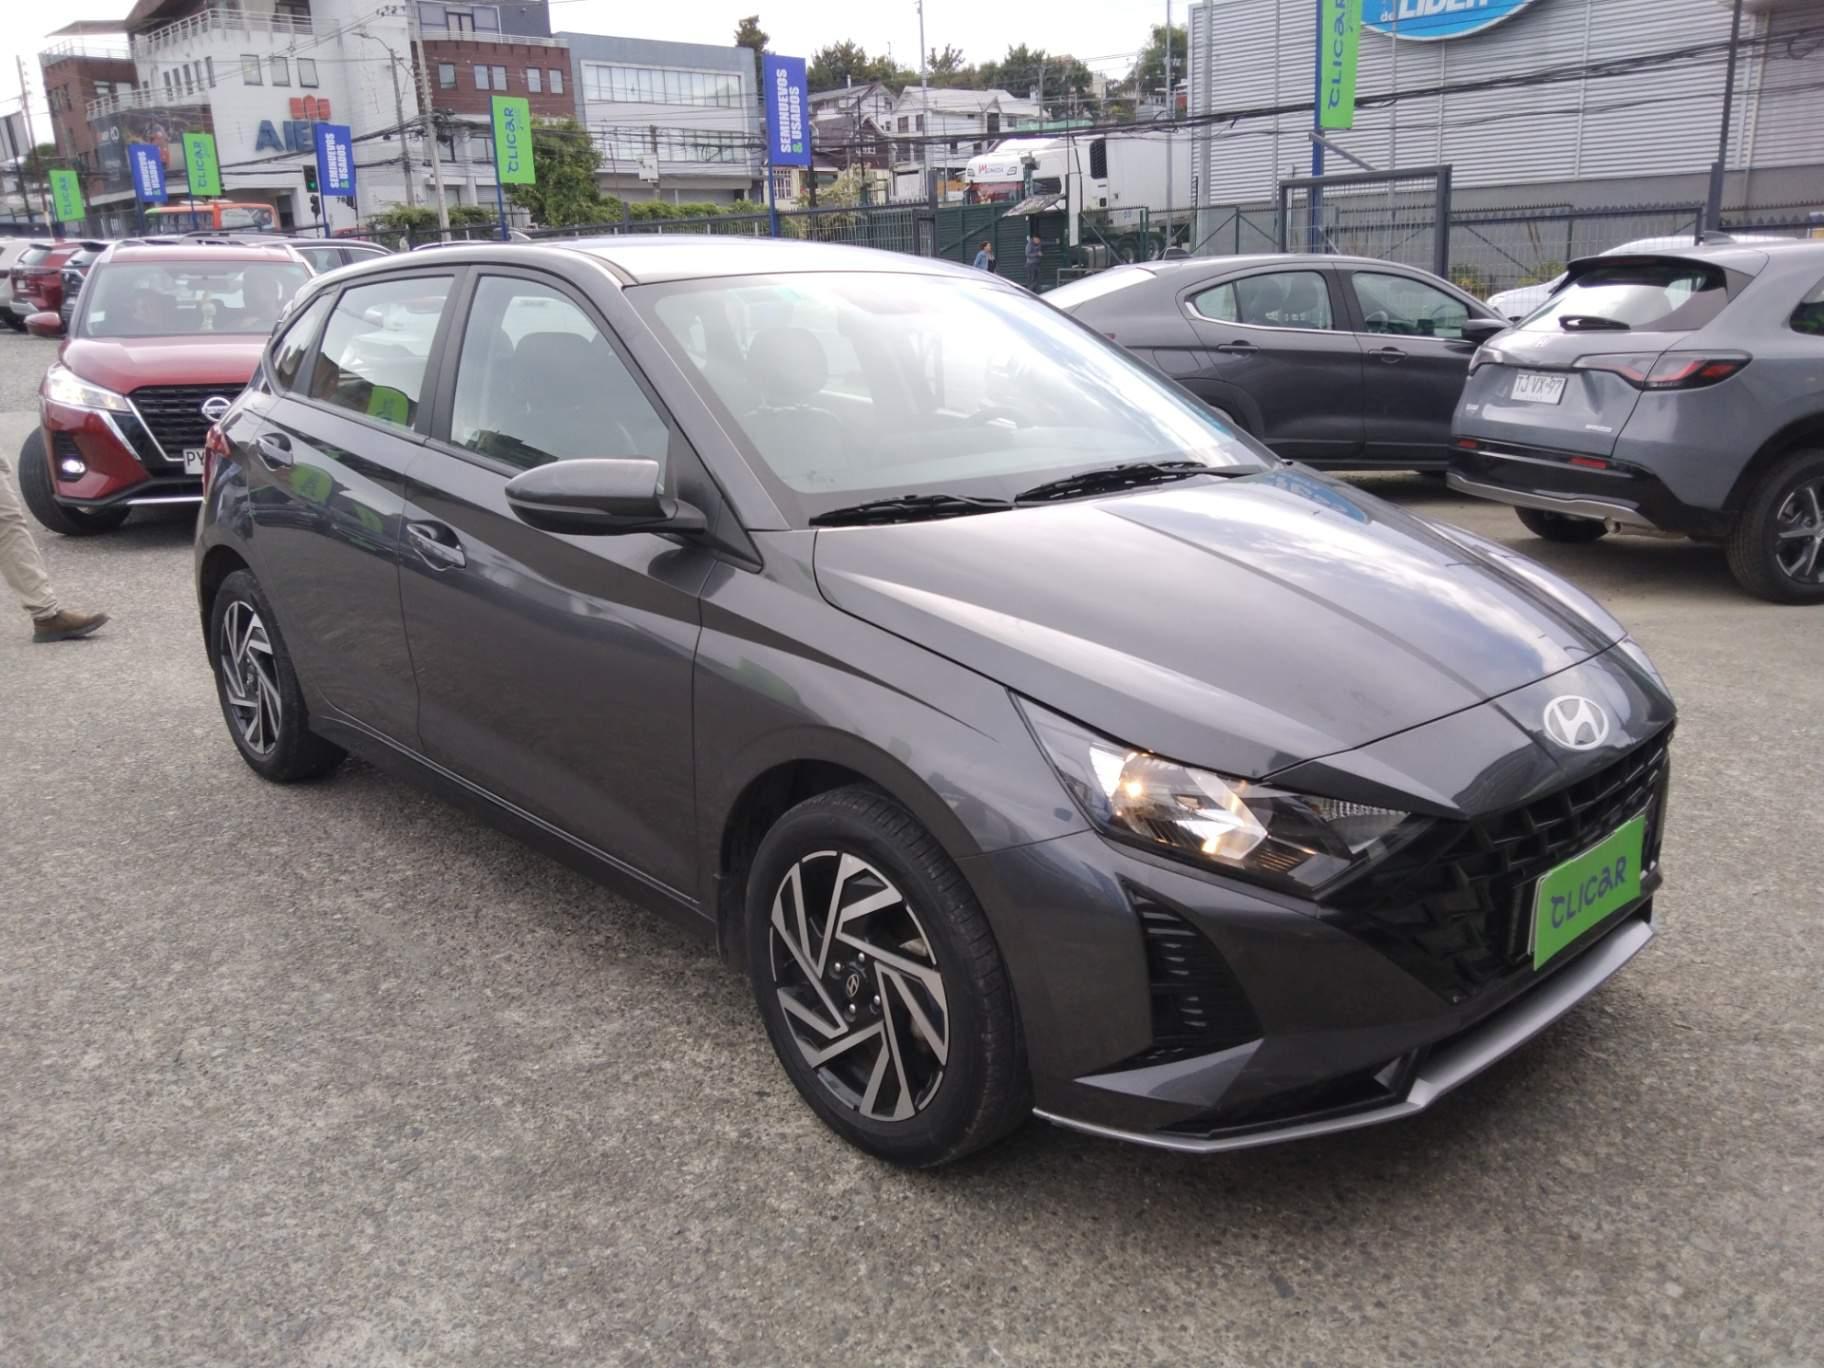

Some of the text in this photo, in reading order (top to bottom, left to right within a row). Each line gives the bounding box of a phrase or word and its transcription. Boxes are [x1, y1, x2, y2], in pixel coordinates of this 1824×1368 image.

[776, 68, 791, 153] SEMINUEVOS
[789, 86, 803, 153] & USADOS
[256, 120, 318, 152] AIE
[325, 133, 339, 188] SEMINUEVOS
[336, 144, 348, 180] USADOS
[186, 451, 205, 467] PY
